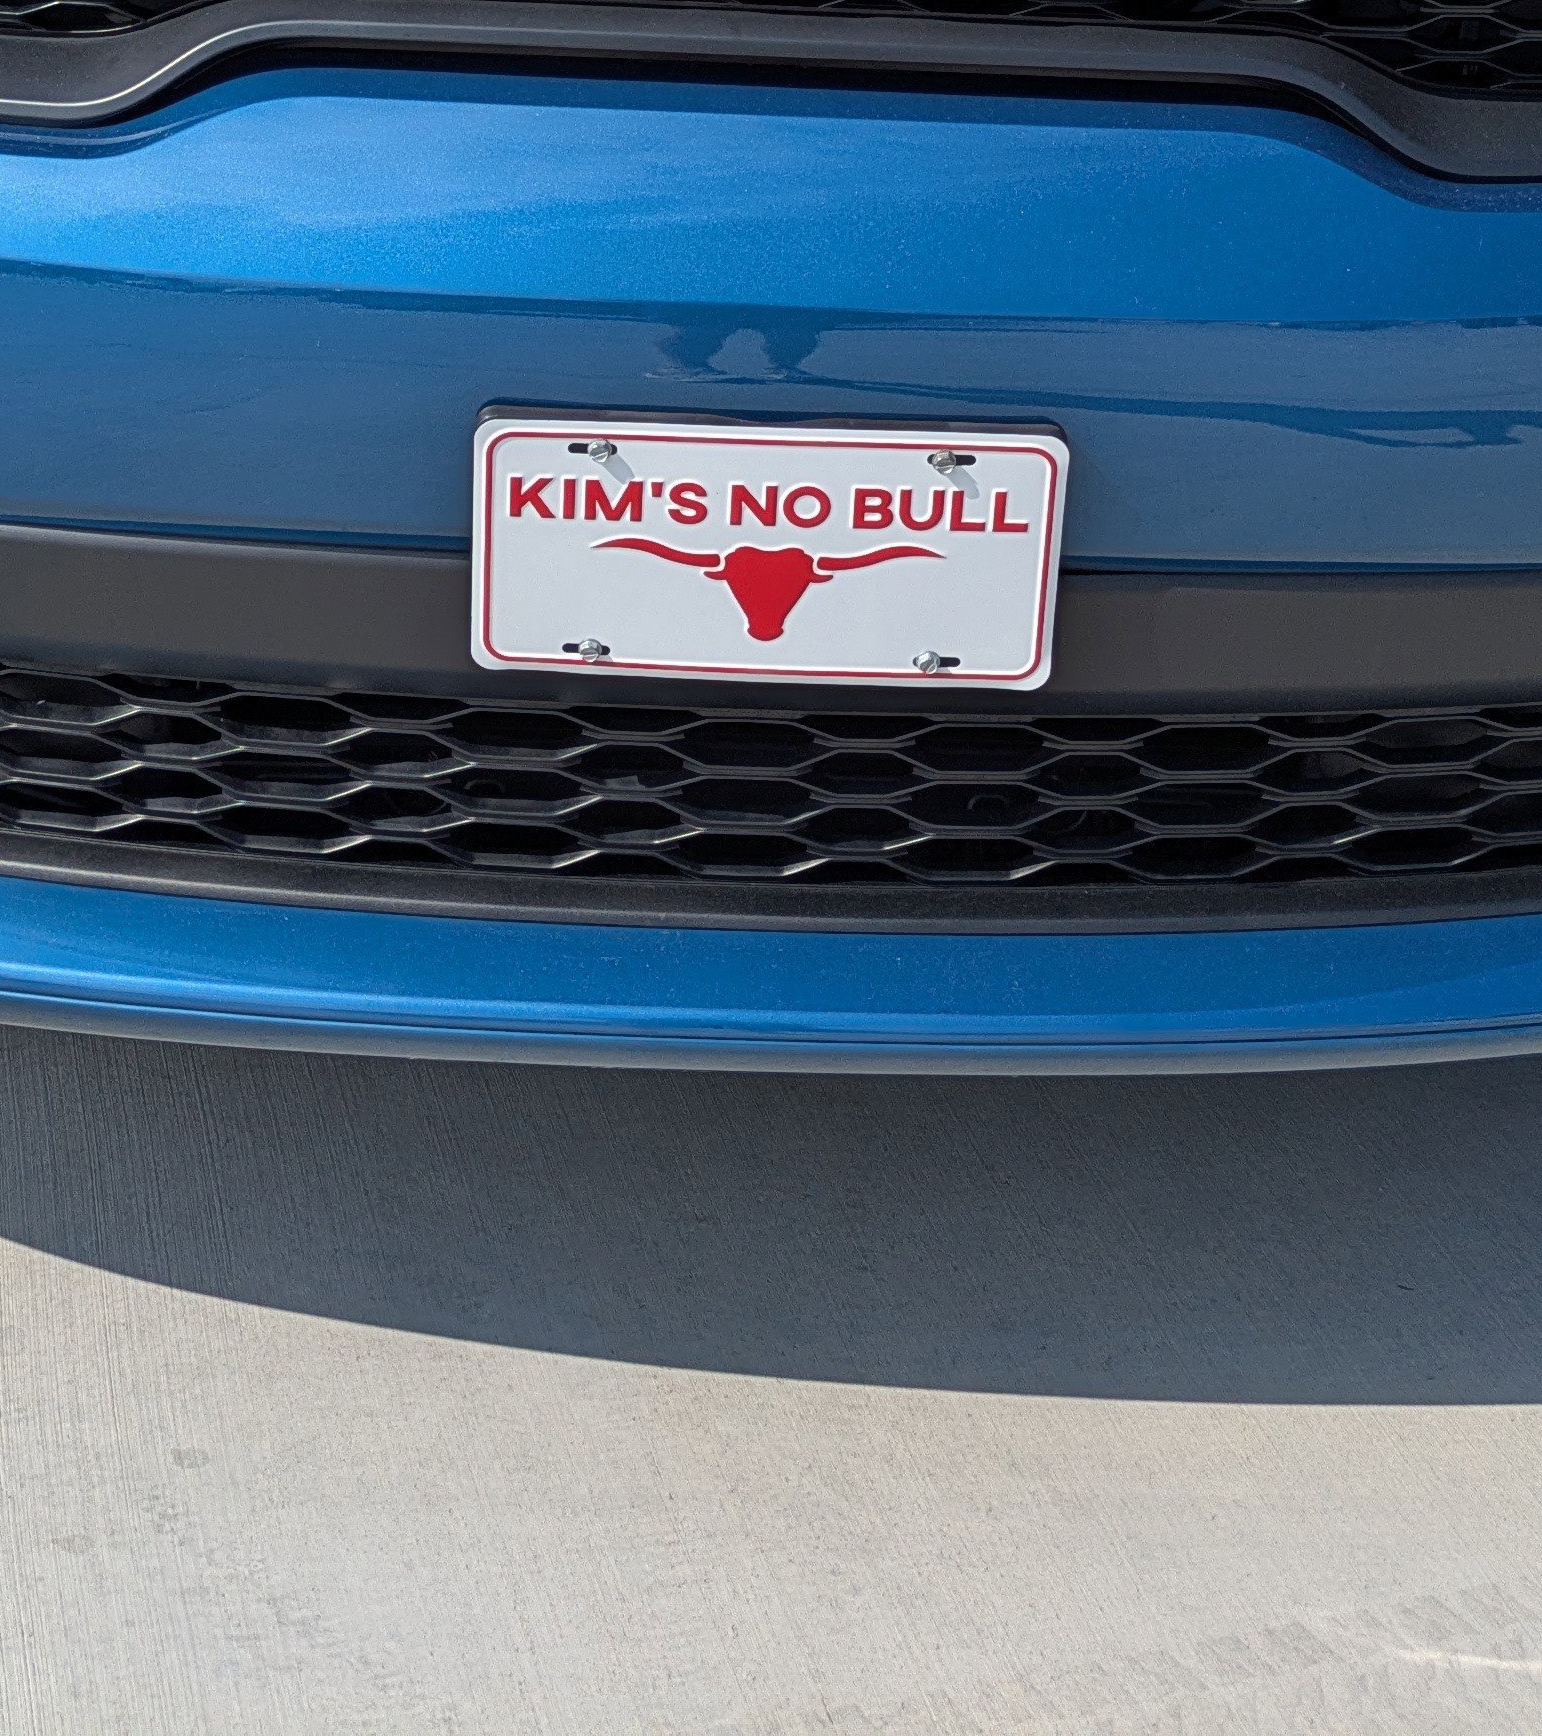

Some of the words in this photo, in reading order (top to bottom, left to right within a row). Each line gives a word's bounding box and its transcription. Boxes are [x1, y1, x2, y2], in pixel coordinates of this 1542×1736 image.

[509, 476, 708, 525] KIM'S
[729, 484, 832, 529] NO
[852, 487, 1029, 533] BULL
